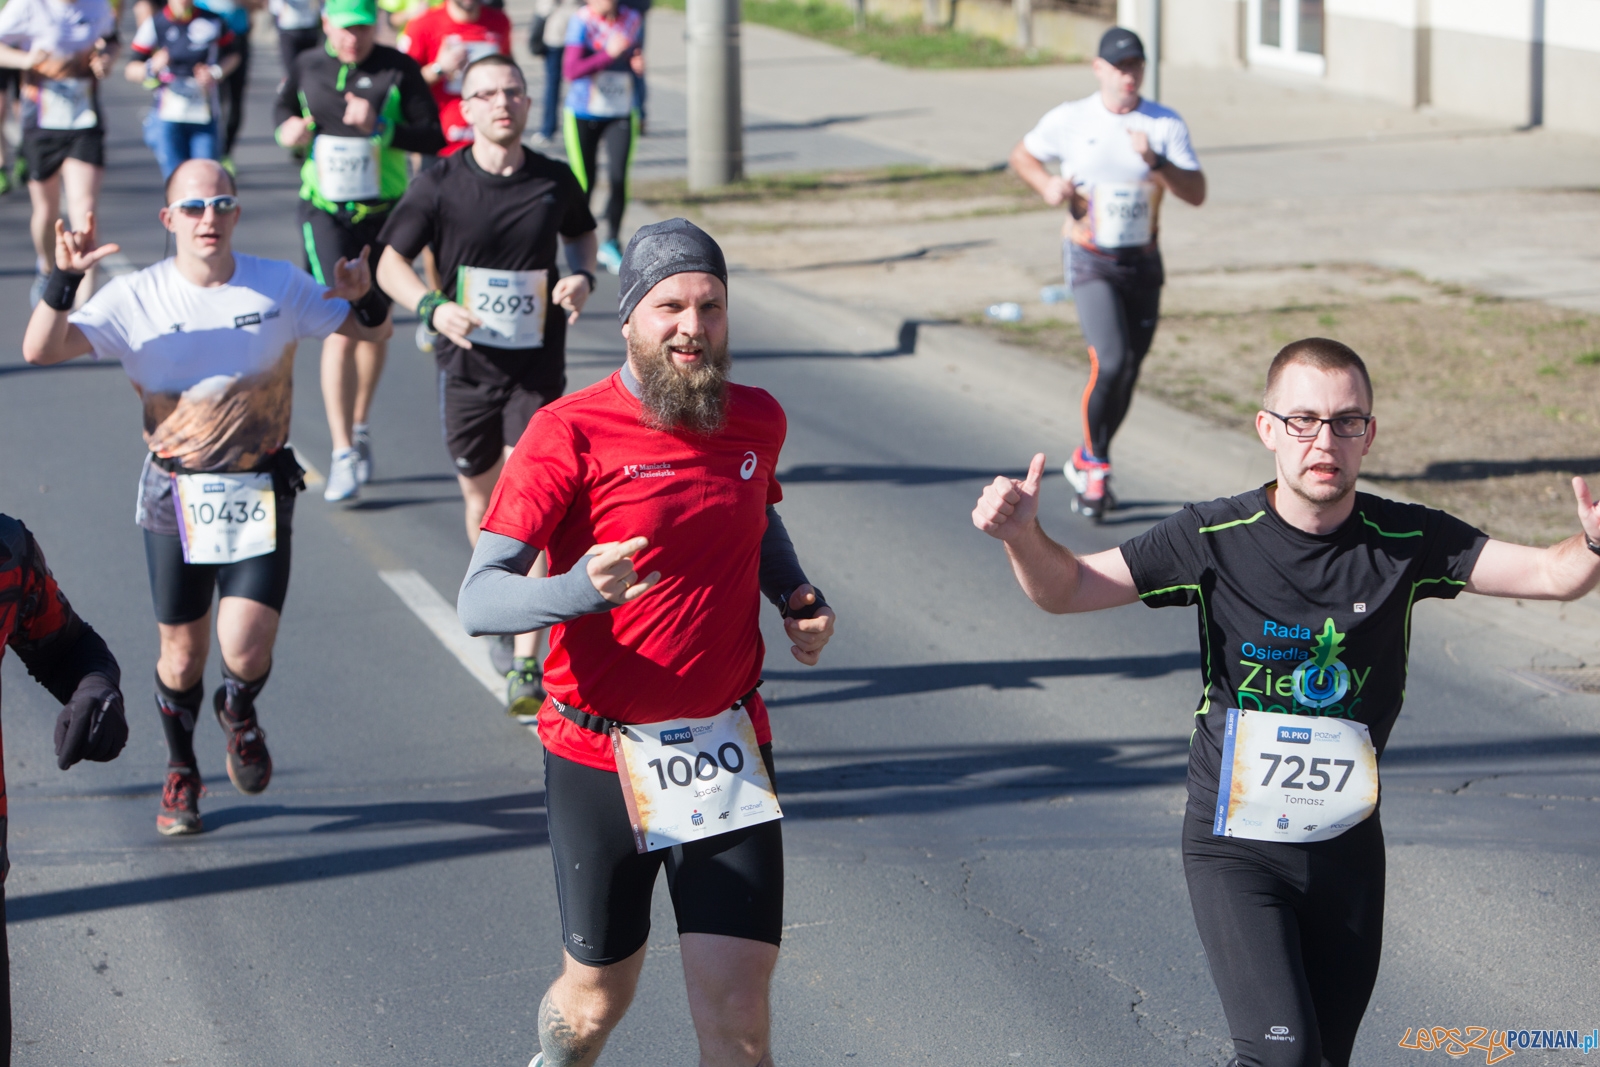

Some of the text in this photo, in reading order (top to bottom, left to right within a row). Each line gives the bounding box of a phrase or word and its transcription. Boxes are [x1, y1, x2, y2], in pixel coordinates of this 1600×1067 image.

[478, 293, 534, 315] 2693
[623, 464, 640, 479] 13
[639, 461, 671, 471] Maniacka
[640, 470, 676, 479] Dziesiątka
[188, 500, 266, 525] 10436
[1263, 620, 1311, 640] Rada
[1241, 642, 1310, 661] Osiedla
[663, 733, 675, 742] 10.
[674, 731, 691, 740] PKO
[1280, 730, 1309, 740] 10. PKO
[648, 742, 744, 790] 1000
[1260, 752, 1355, 793] 7257
[693, 784, 723, 798] Jacek
[1284, 794, 1325, 806] Tomasz
[718, 811, 730, 820] 4F
[1265, 1033, 1296, 1043] Kalenji
